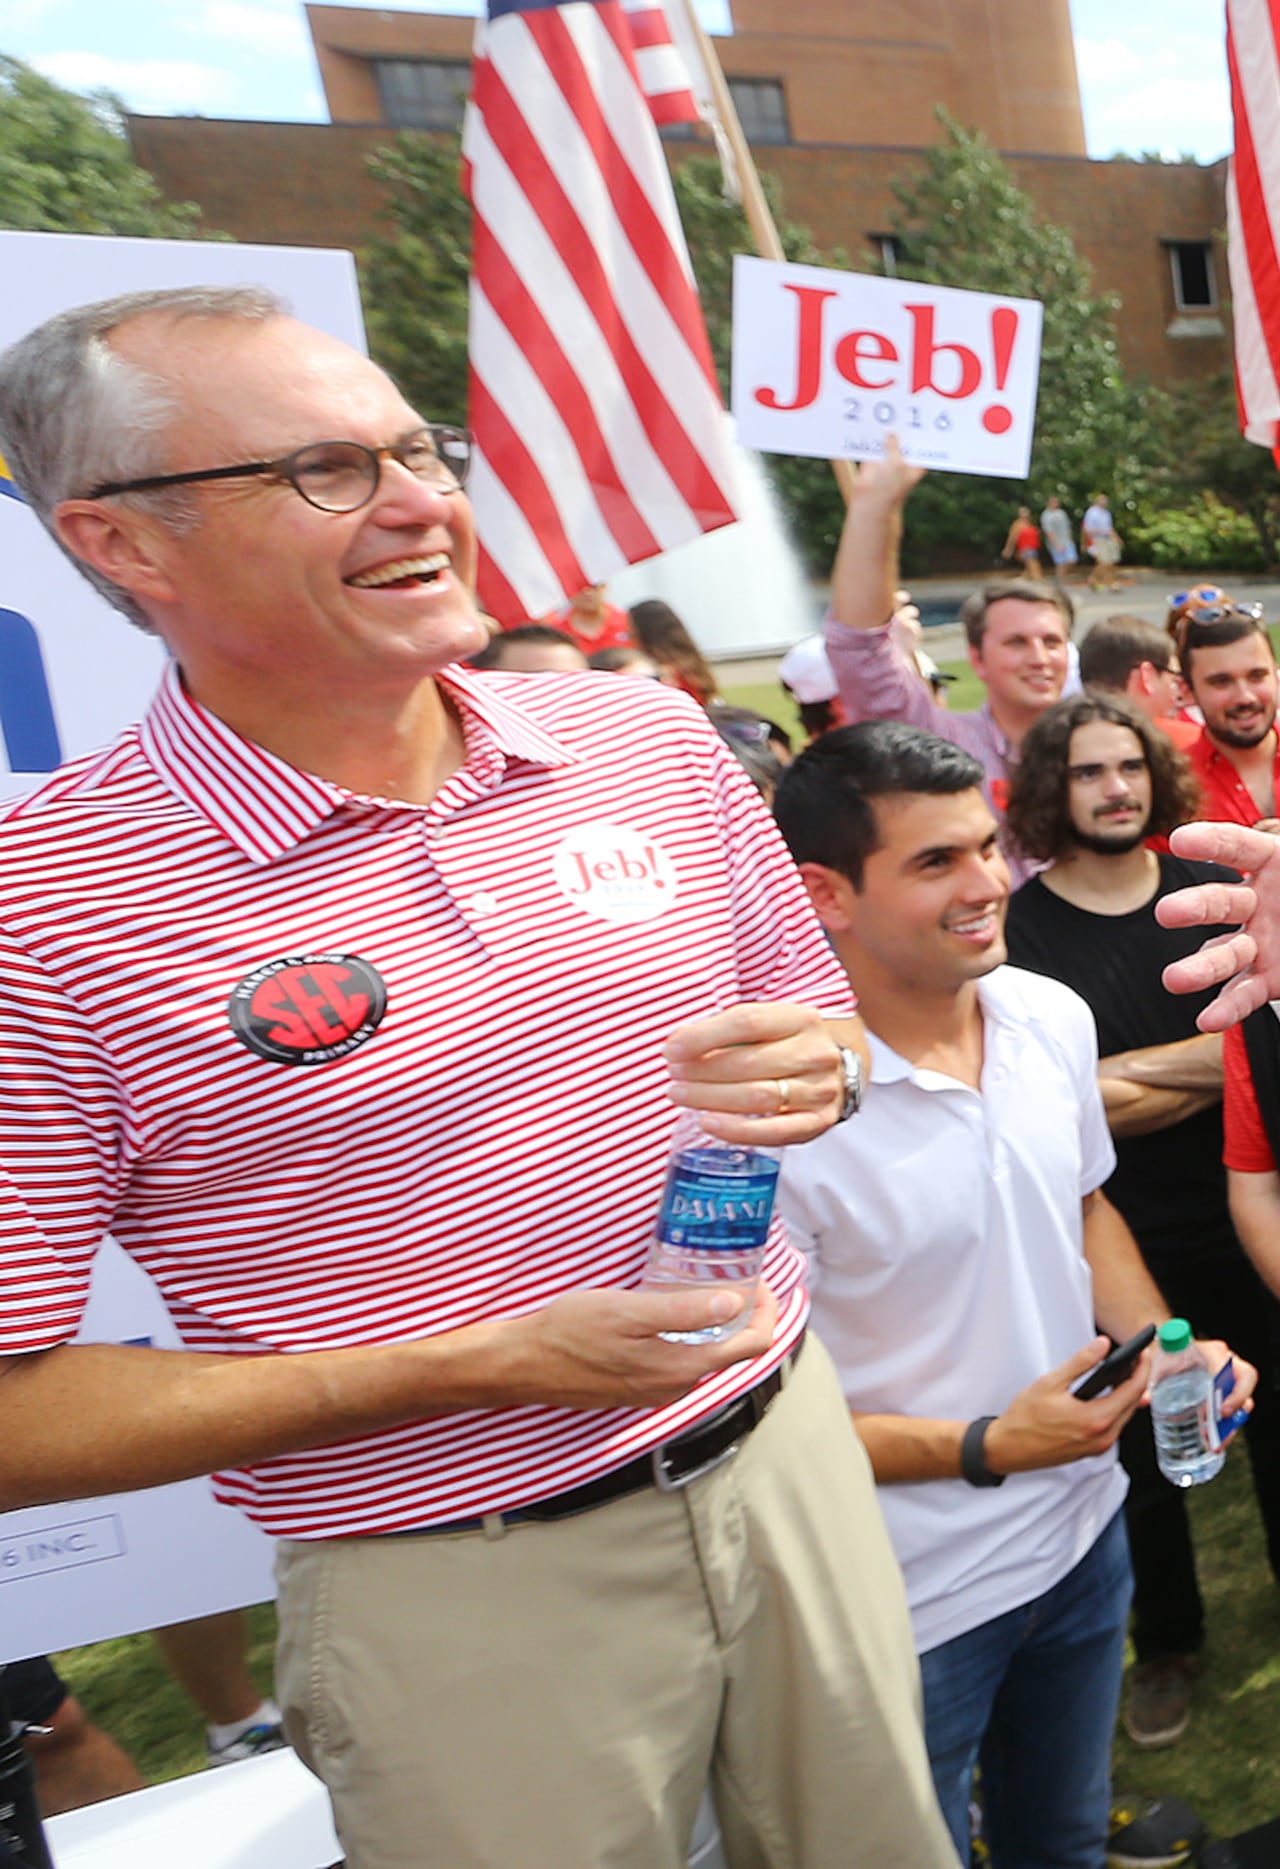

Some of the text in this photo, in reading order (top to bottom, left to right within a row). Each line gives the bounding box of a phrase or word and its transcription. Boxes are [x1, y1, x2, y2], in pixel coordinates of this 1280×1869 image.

[754, 283, 1018, 434] Jeb!
[843, 397, 952, 431] 2016
[568, 845, 665, 894] Jeb!
[251, 963, 370, 1049] SEC
[671, 1194, 766, 1222] DASANI
